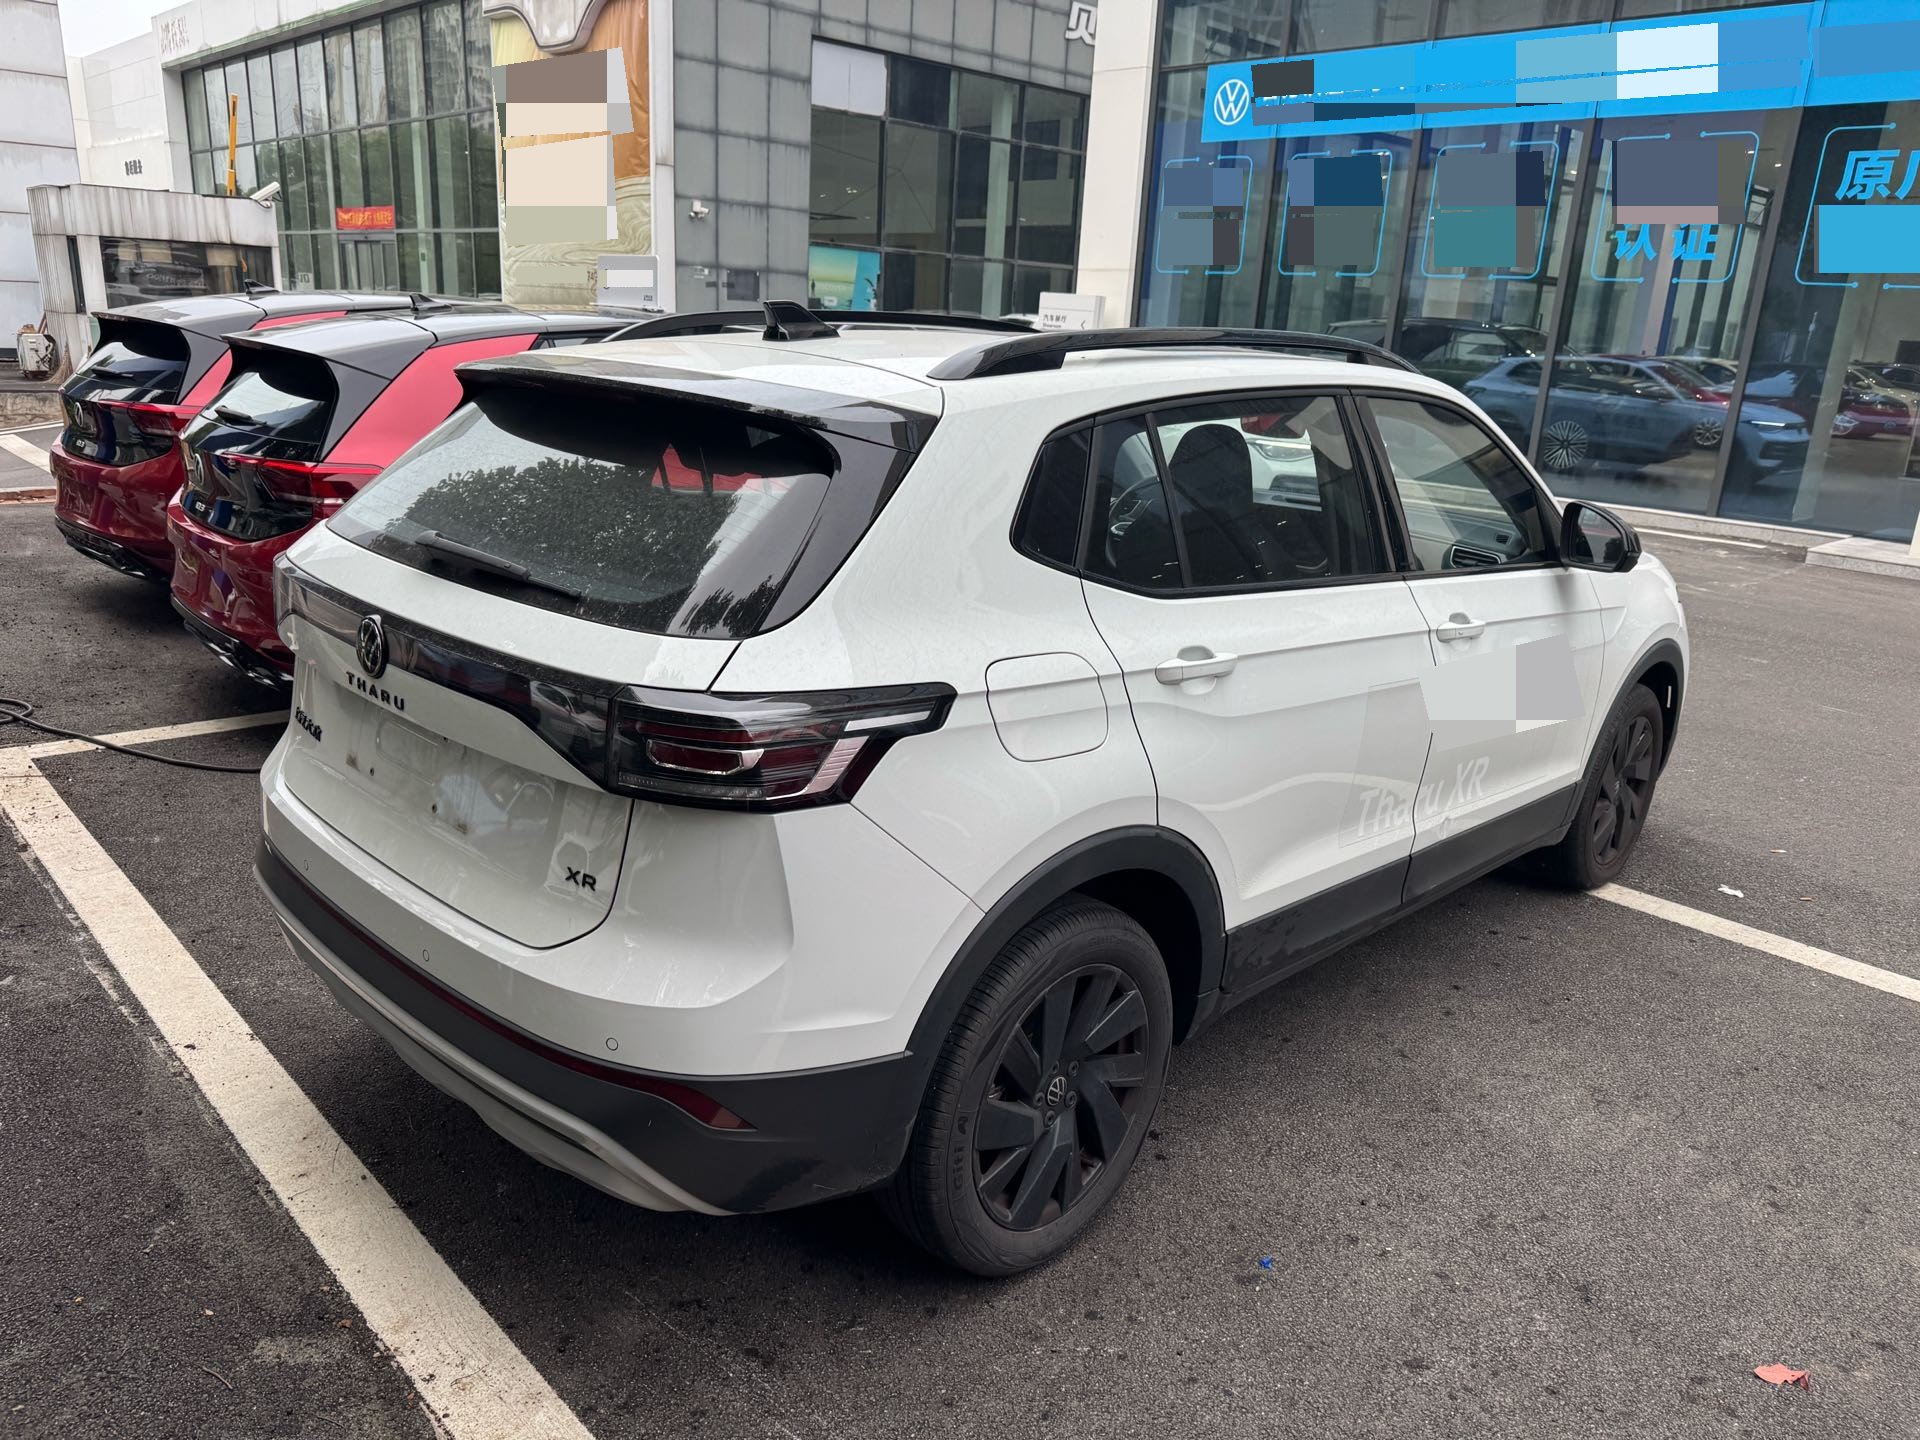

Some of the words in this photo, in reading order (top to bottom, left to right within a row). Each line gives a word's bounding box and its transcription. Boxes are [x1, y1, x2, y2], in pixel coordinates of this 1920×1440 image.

[346, 671, 405, 711] THARU
[1359, 780, 1444, 836] Tharu
[1446, 756, 1490, 808] XR
[565, 866, 597, 892] XR
